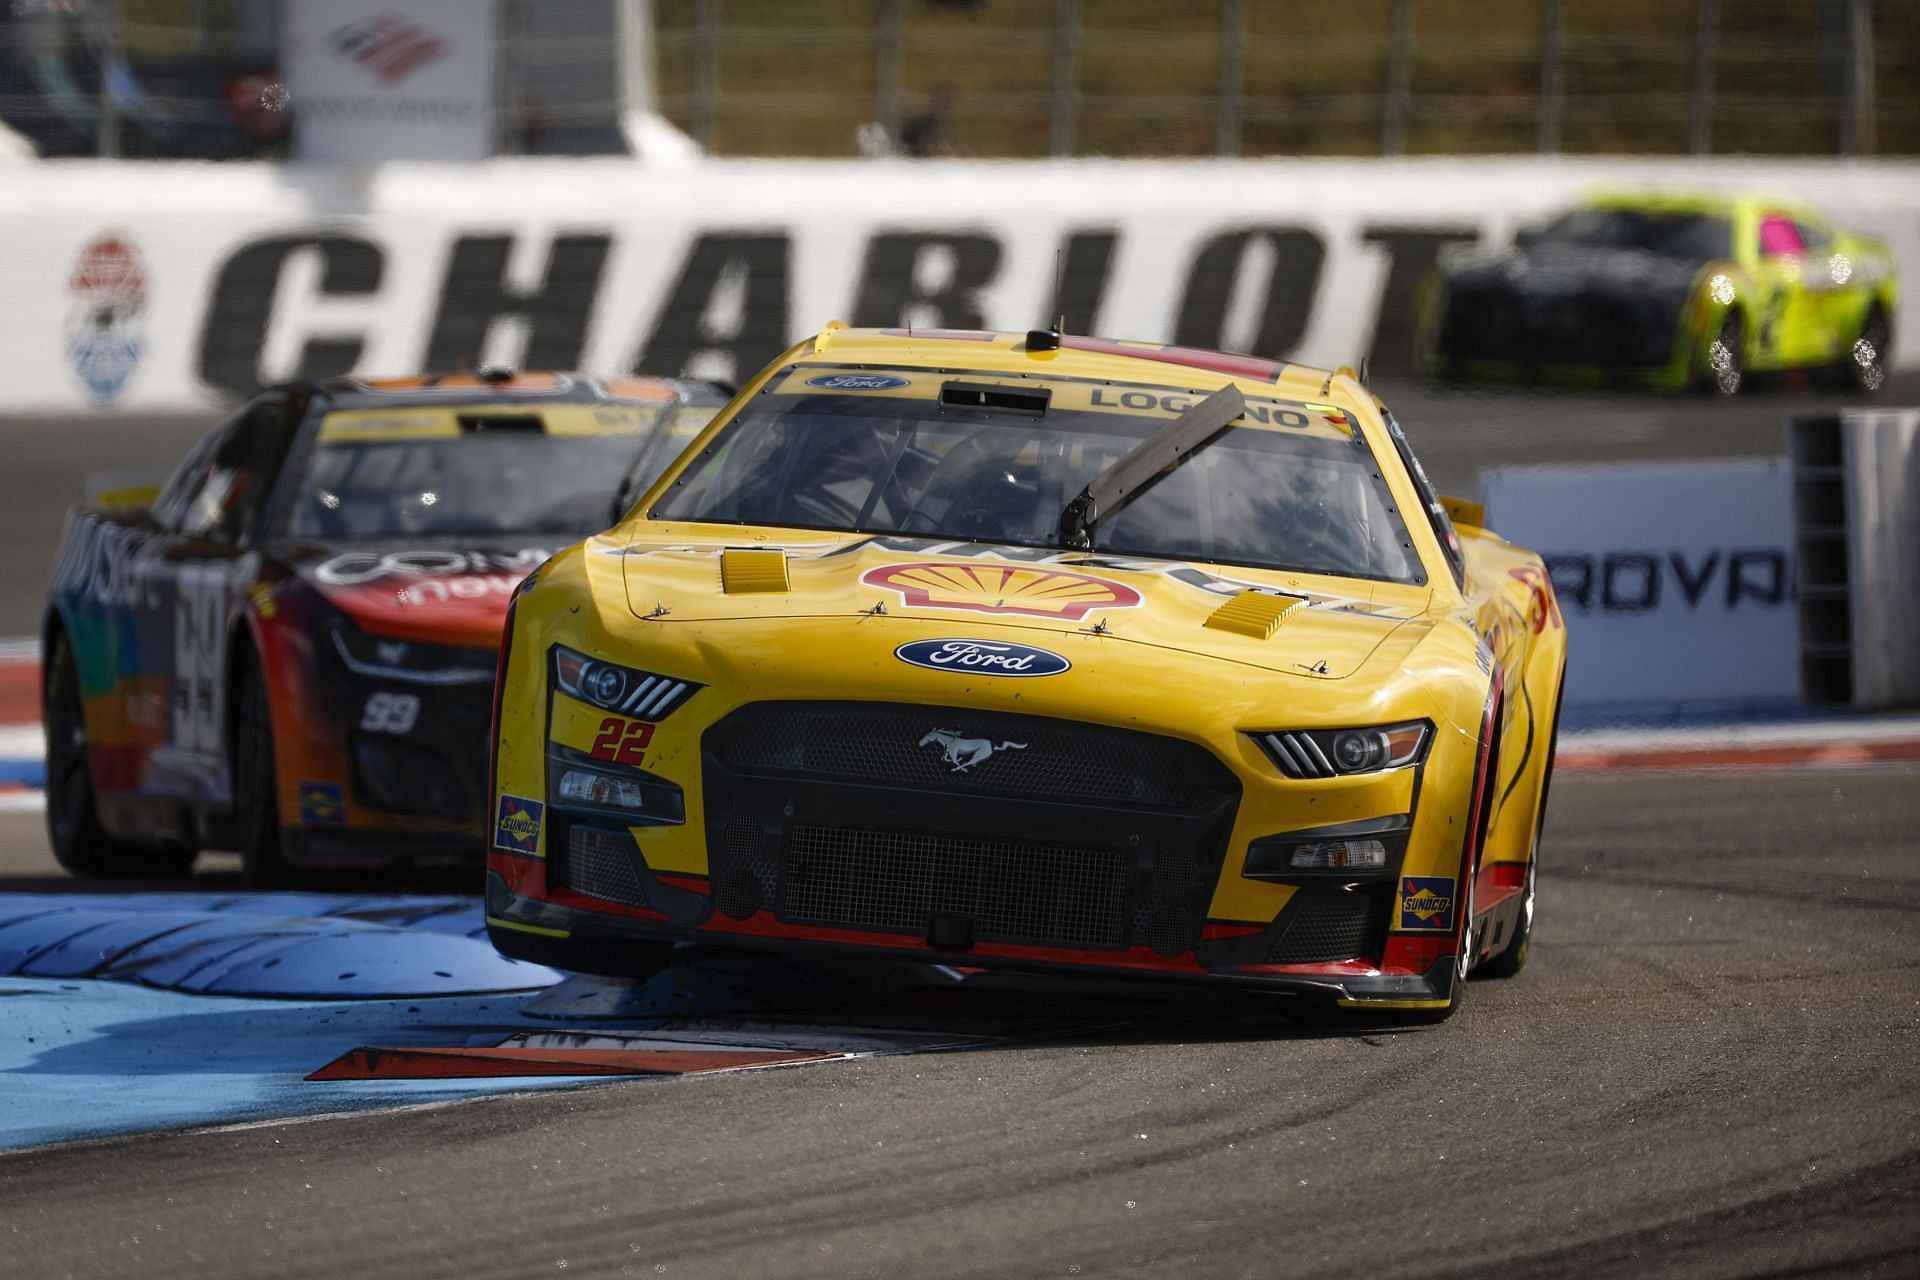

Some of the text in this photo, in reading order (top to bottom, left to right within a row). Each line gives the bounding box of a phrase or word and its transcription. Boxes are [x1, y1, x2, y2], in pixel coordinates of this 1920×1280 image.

[826, 373, 889, 390] Ford
[1090, 387, 1310, 429] LOGNO
[929, 640, 1034, 672] Ford
[360, 692, 420, 735] 99
[590, 717, 656, 767] 22
[502, 816, 539, 836] SUNOCO
[1404, 897, 1450, 912] SUNOCO
